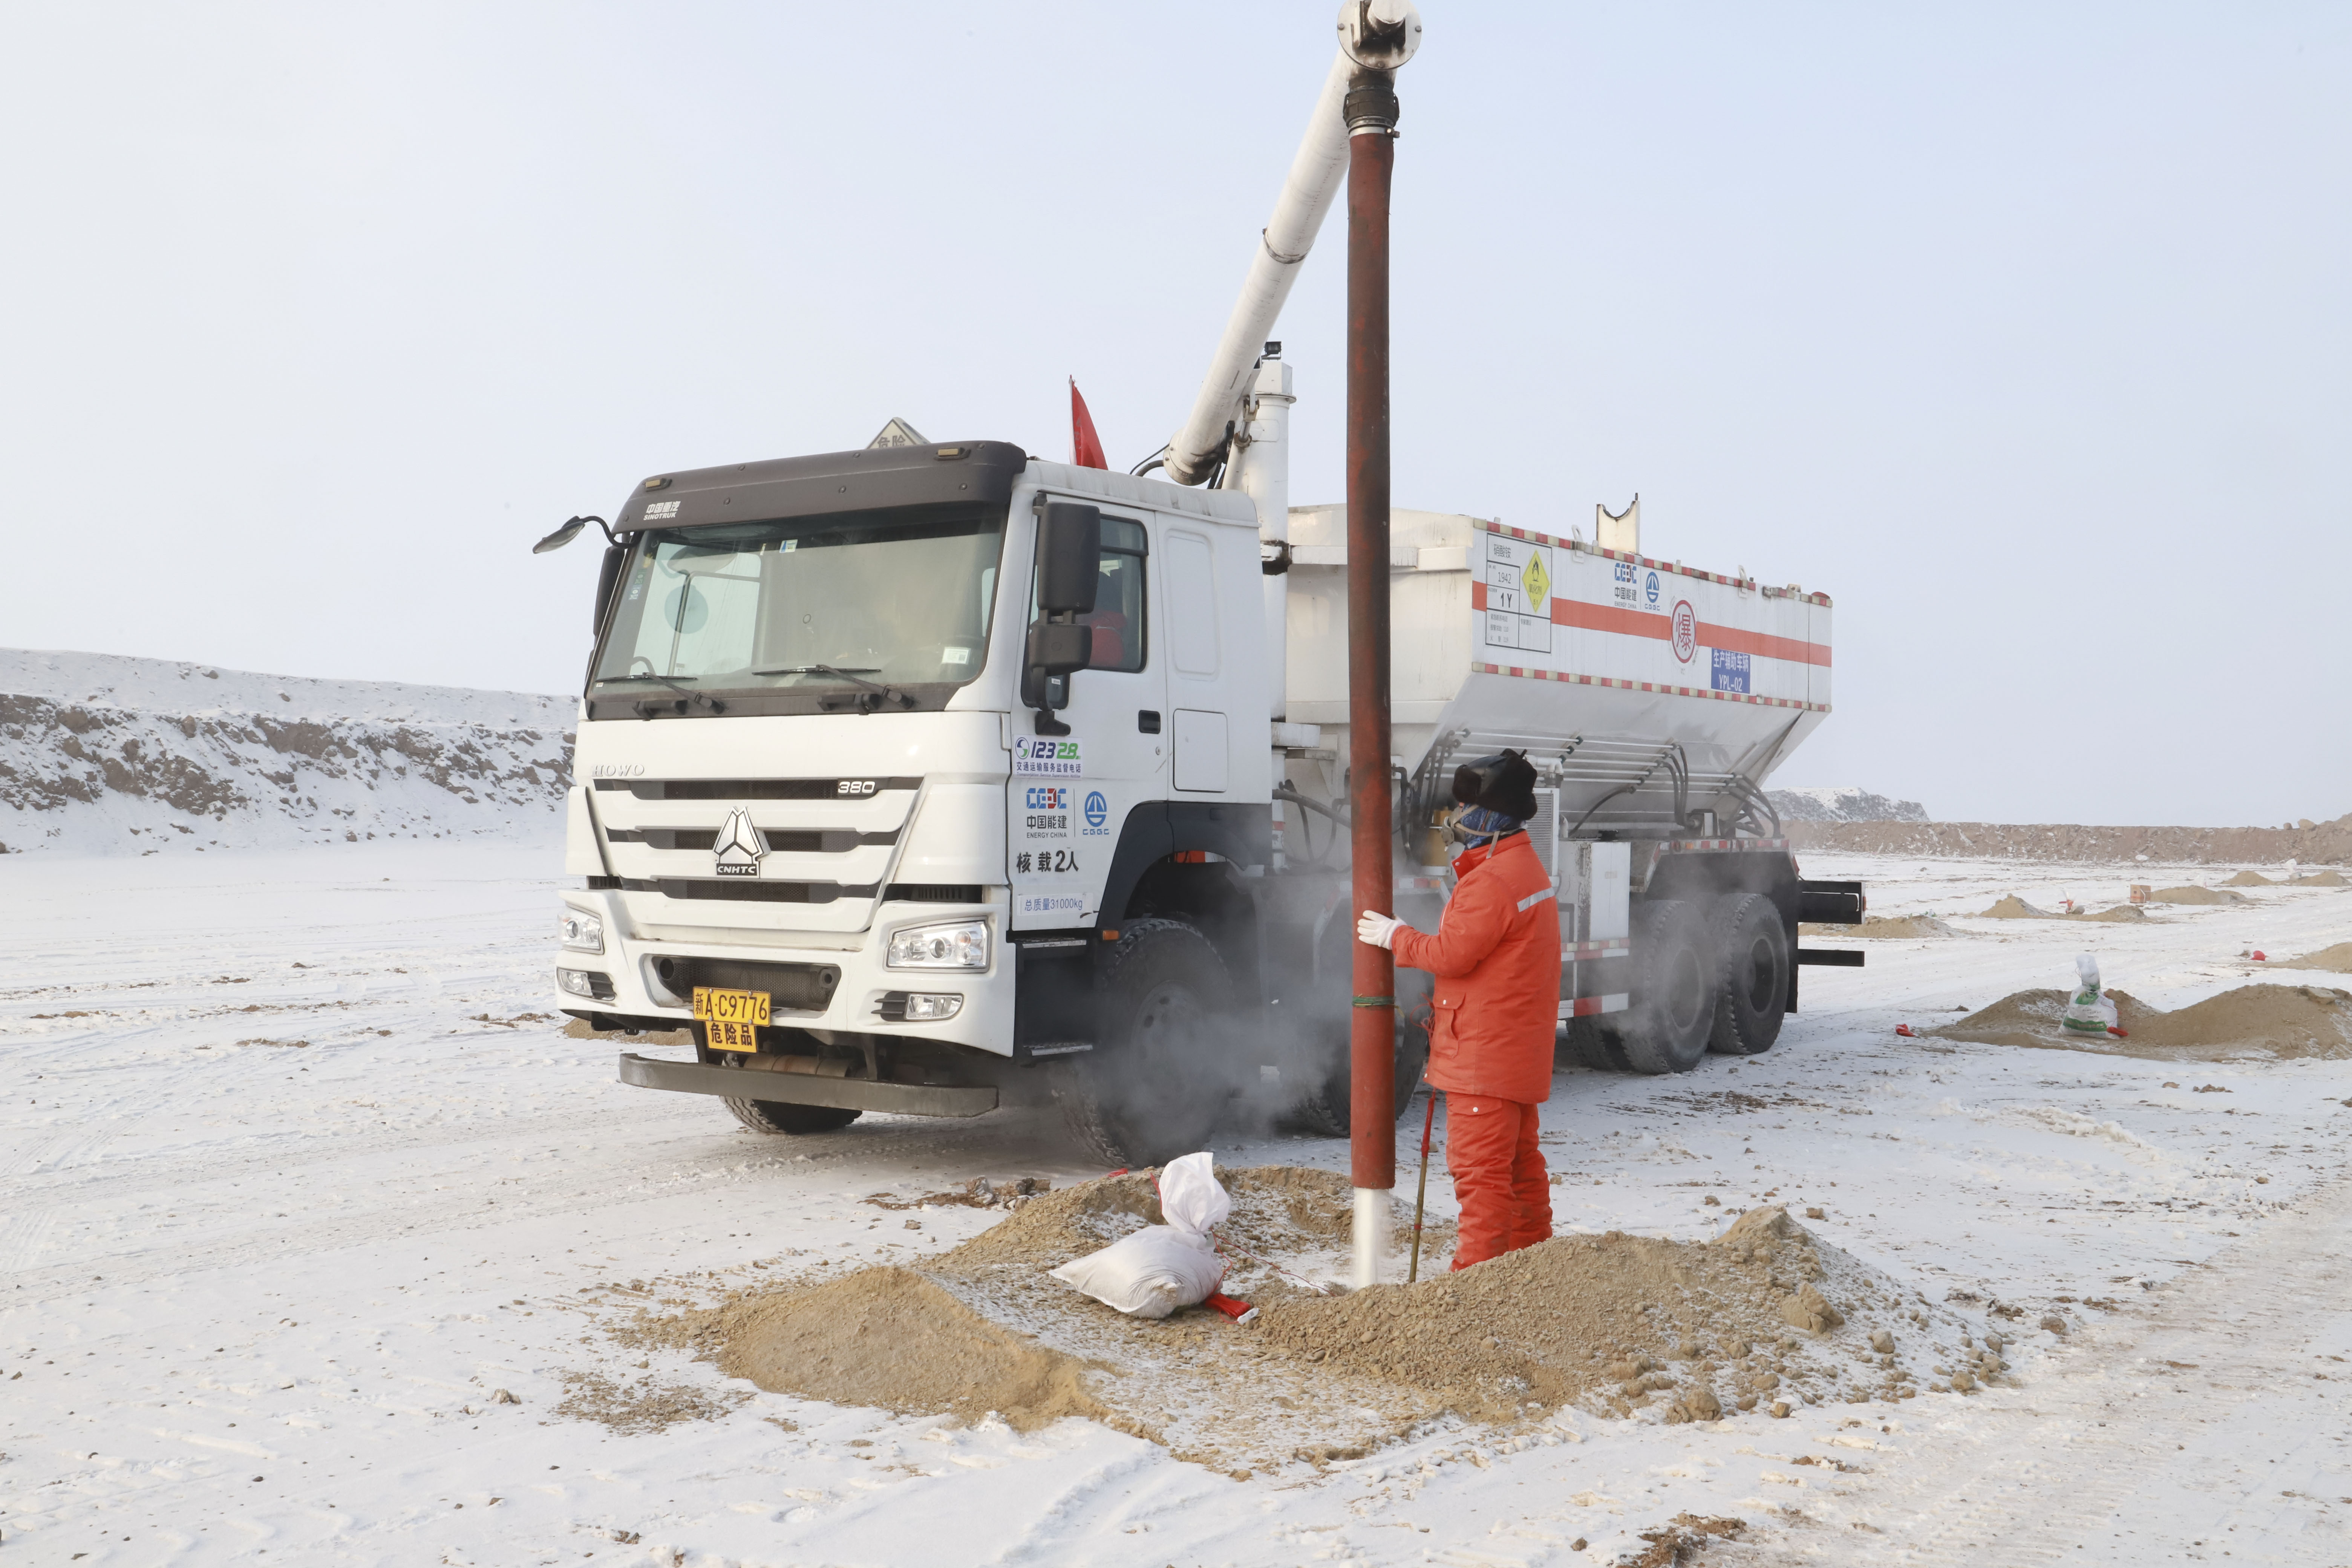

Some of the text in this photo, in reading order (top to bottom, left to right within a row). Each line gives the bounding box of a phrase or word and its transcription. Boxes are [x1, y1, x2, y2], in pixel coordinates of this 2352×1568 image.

[646, 501, 681, 514] 中国重汽
[643, 512, 677, 521] SINOTRUK
[1494, 544, 1511, 559] 硝酸铵
[1498, 571, 1511, 584] 1942
[1615, 586, 1637, 602] 中国能建
[1677, 613, 1692, 652] 爆
[1713, 649, 1749, 672] 生产辅助车辆
[1719, 674, 1743, 692] YPL-02
[591, 764, 645, 777] HOWO
[1017, 761, 1081, 773] 交通运输服务监督电话
[838, 781, 876, 794] 380
[1027, 815, 1067, 829] 中国能建
[717, 865, 756, 874] CNHTC
[1024, 898, 1083, 911] 总质量31000kg
[710, 1022, 752, 1046] 危险品
